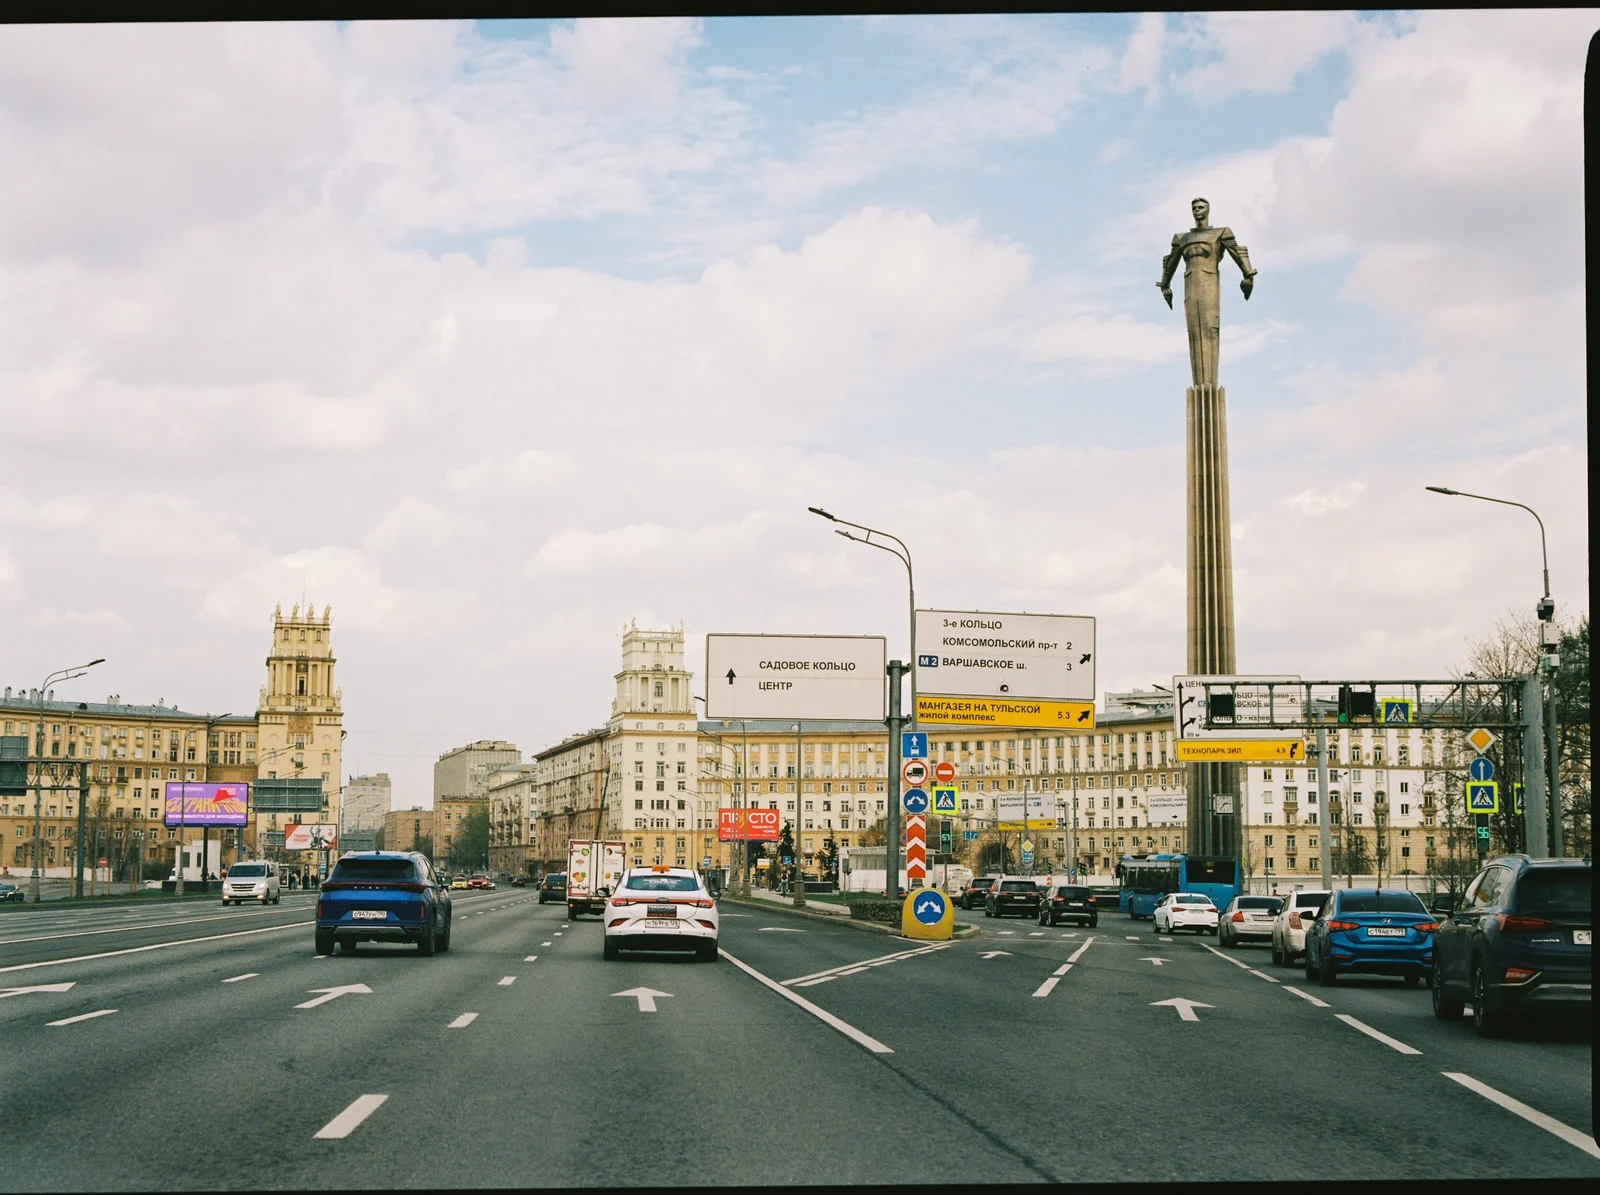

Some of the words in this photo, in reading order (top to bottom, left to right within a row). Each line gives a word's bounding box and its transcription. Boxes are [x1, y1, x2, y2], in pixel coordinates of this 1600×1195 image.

[943, 619, 958, 628] 3-е
[960, 619, 1002, 631] КОЛЬЦО
[943, 637, 1035, 649] КОМСОМОЛЬСКИЙ
[1038, 642, 1058, 651] пр-т
[1066, 642, 1073, 650] 2
[759, 661, 810, 671] САДОВОЕ
[813, 661, 856, 672] КОЛЬЦО
[943, 657, 1014, 669] ВАРШАВСКОЕ
[1066, 663, 1073, 671] 3
[759, 682, 793, 691] ЦЕНТР
[919, 701, 971, 711] МАНГАЗЕЯ
[974, 703, 987, 712] НА
[991, 703, 1041, 714] ТУЛЬСКОЙ
[919, 711, 949, 720] жилой
[1057, 711, 1071, 720] 5.3
[941, 833, 951, 841] 57
[1477, 826, 1489, 839] 56
